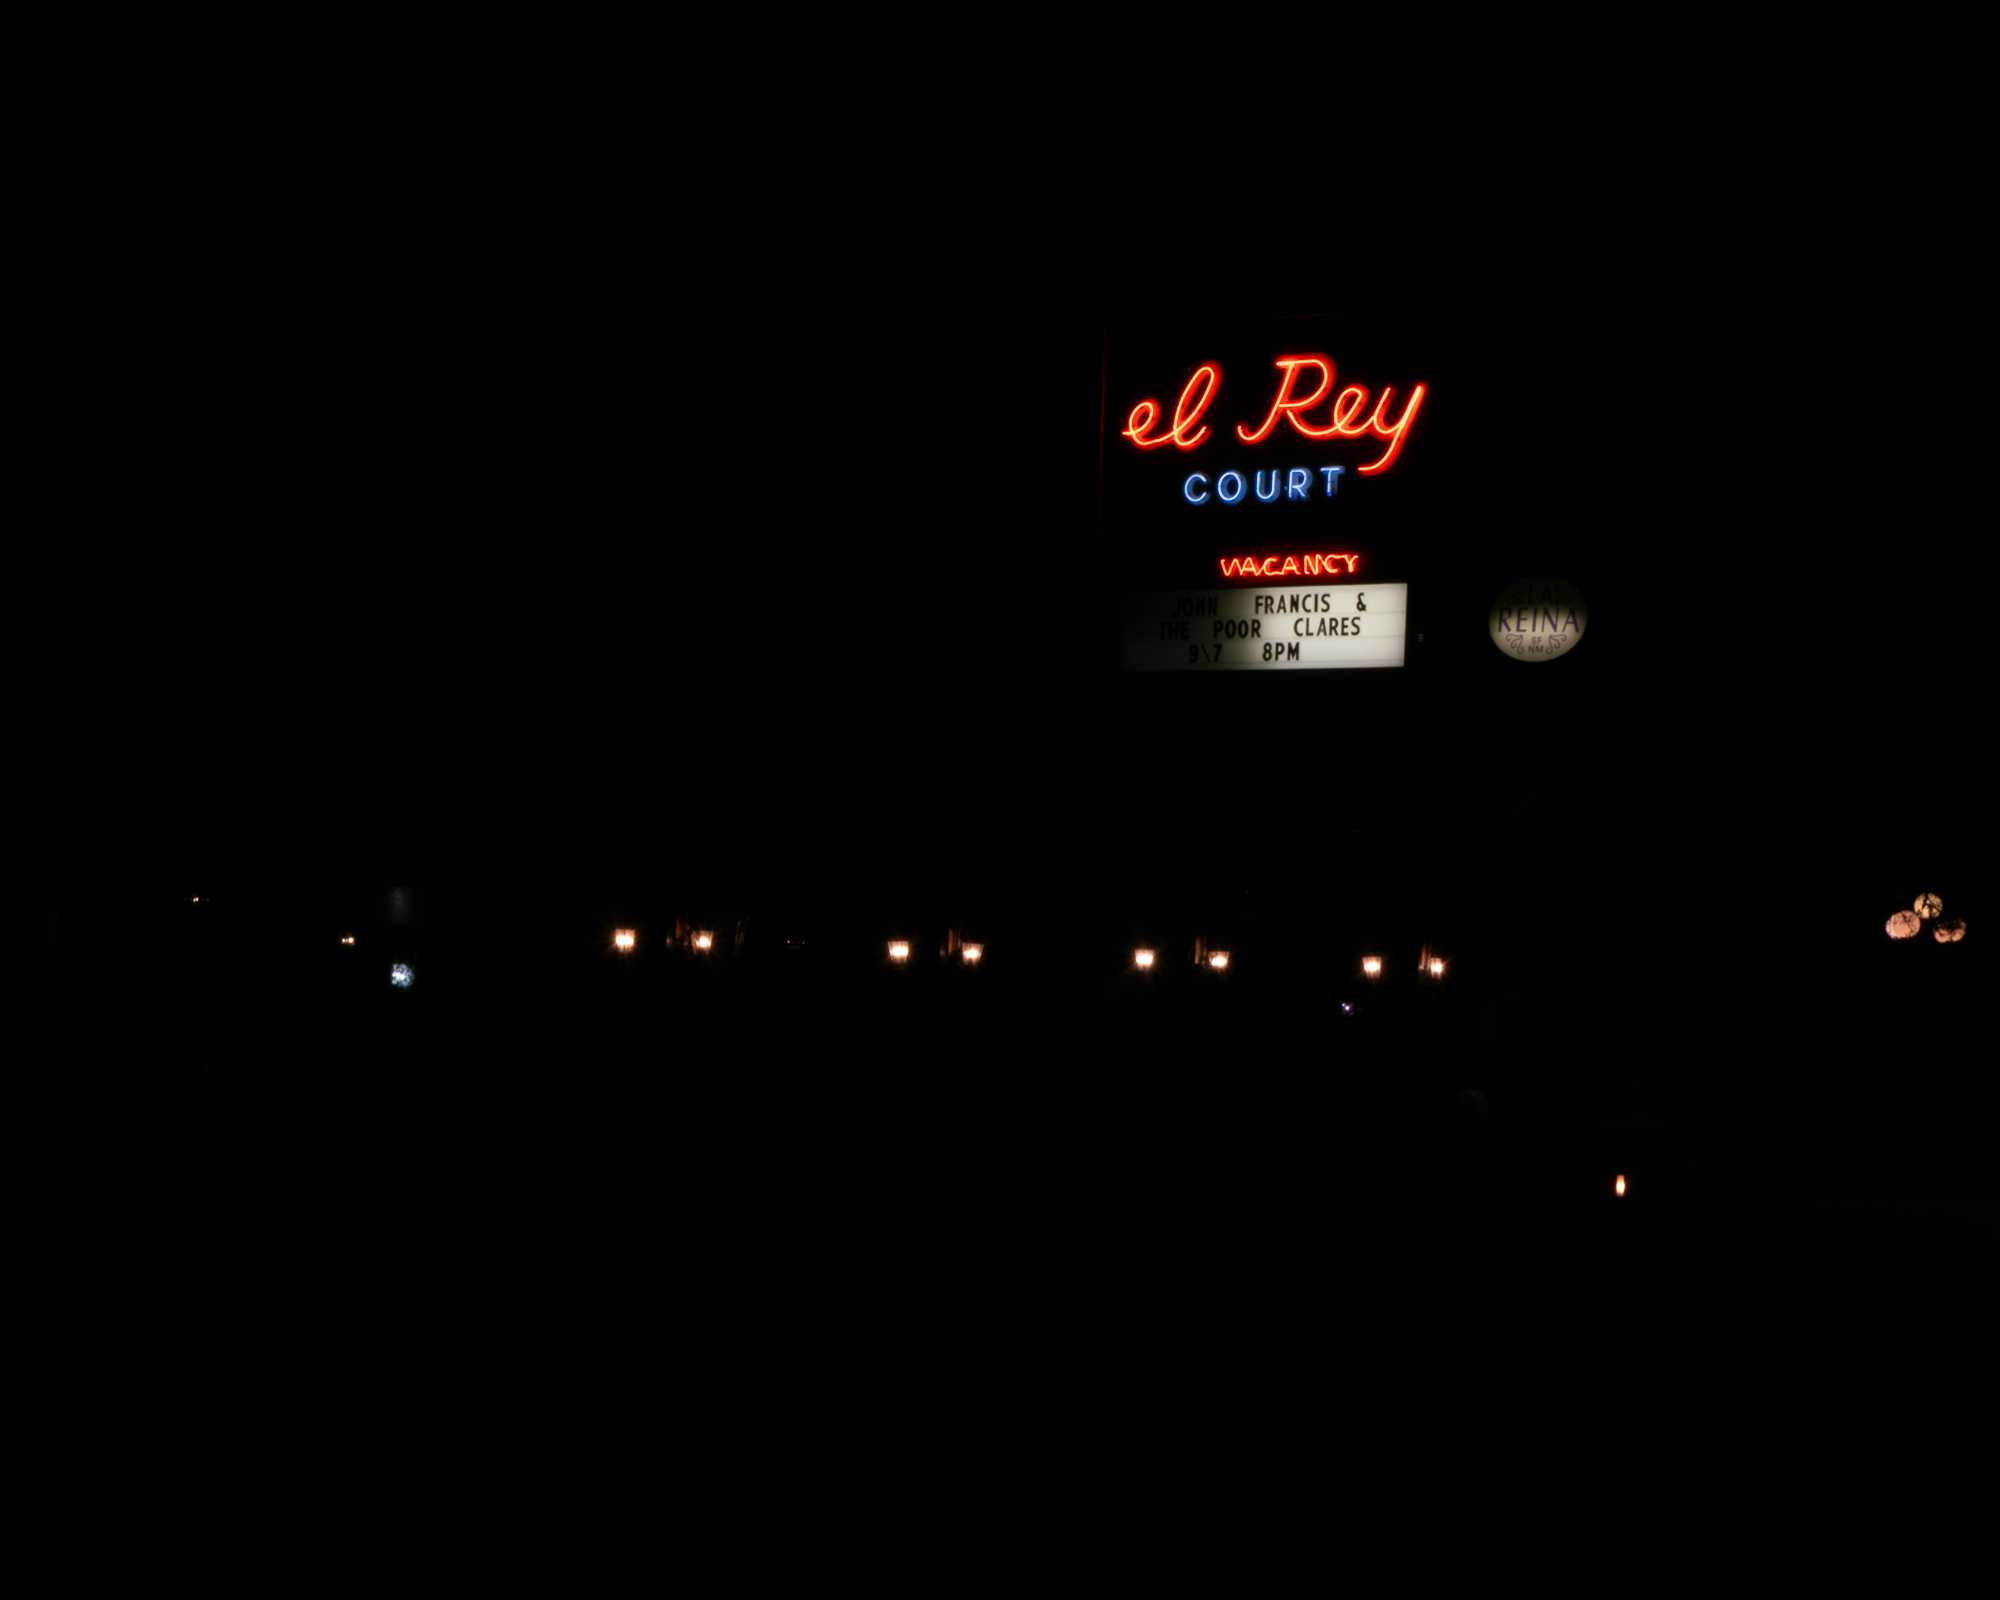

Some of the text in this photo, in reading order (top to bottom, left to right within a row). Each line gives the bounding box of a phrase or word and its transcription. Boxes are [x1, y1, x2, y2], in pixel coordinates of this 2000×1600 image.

[1121, 354, 1427, 476] el Rey
[1183, 465, 1346, 505] COURT
[1220, 553, 1360, 577] VACANCY
[1171, 592, 1367, 617] JOHN FRANCIS &
[1527, 584, 1553, 605] LA
[1159, 617, 1361, 640] THE POOR CLARES
[1497, 606, 1579, 632] REINA
[1262, 642, 1300, 661] 8PM
